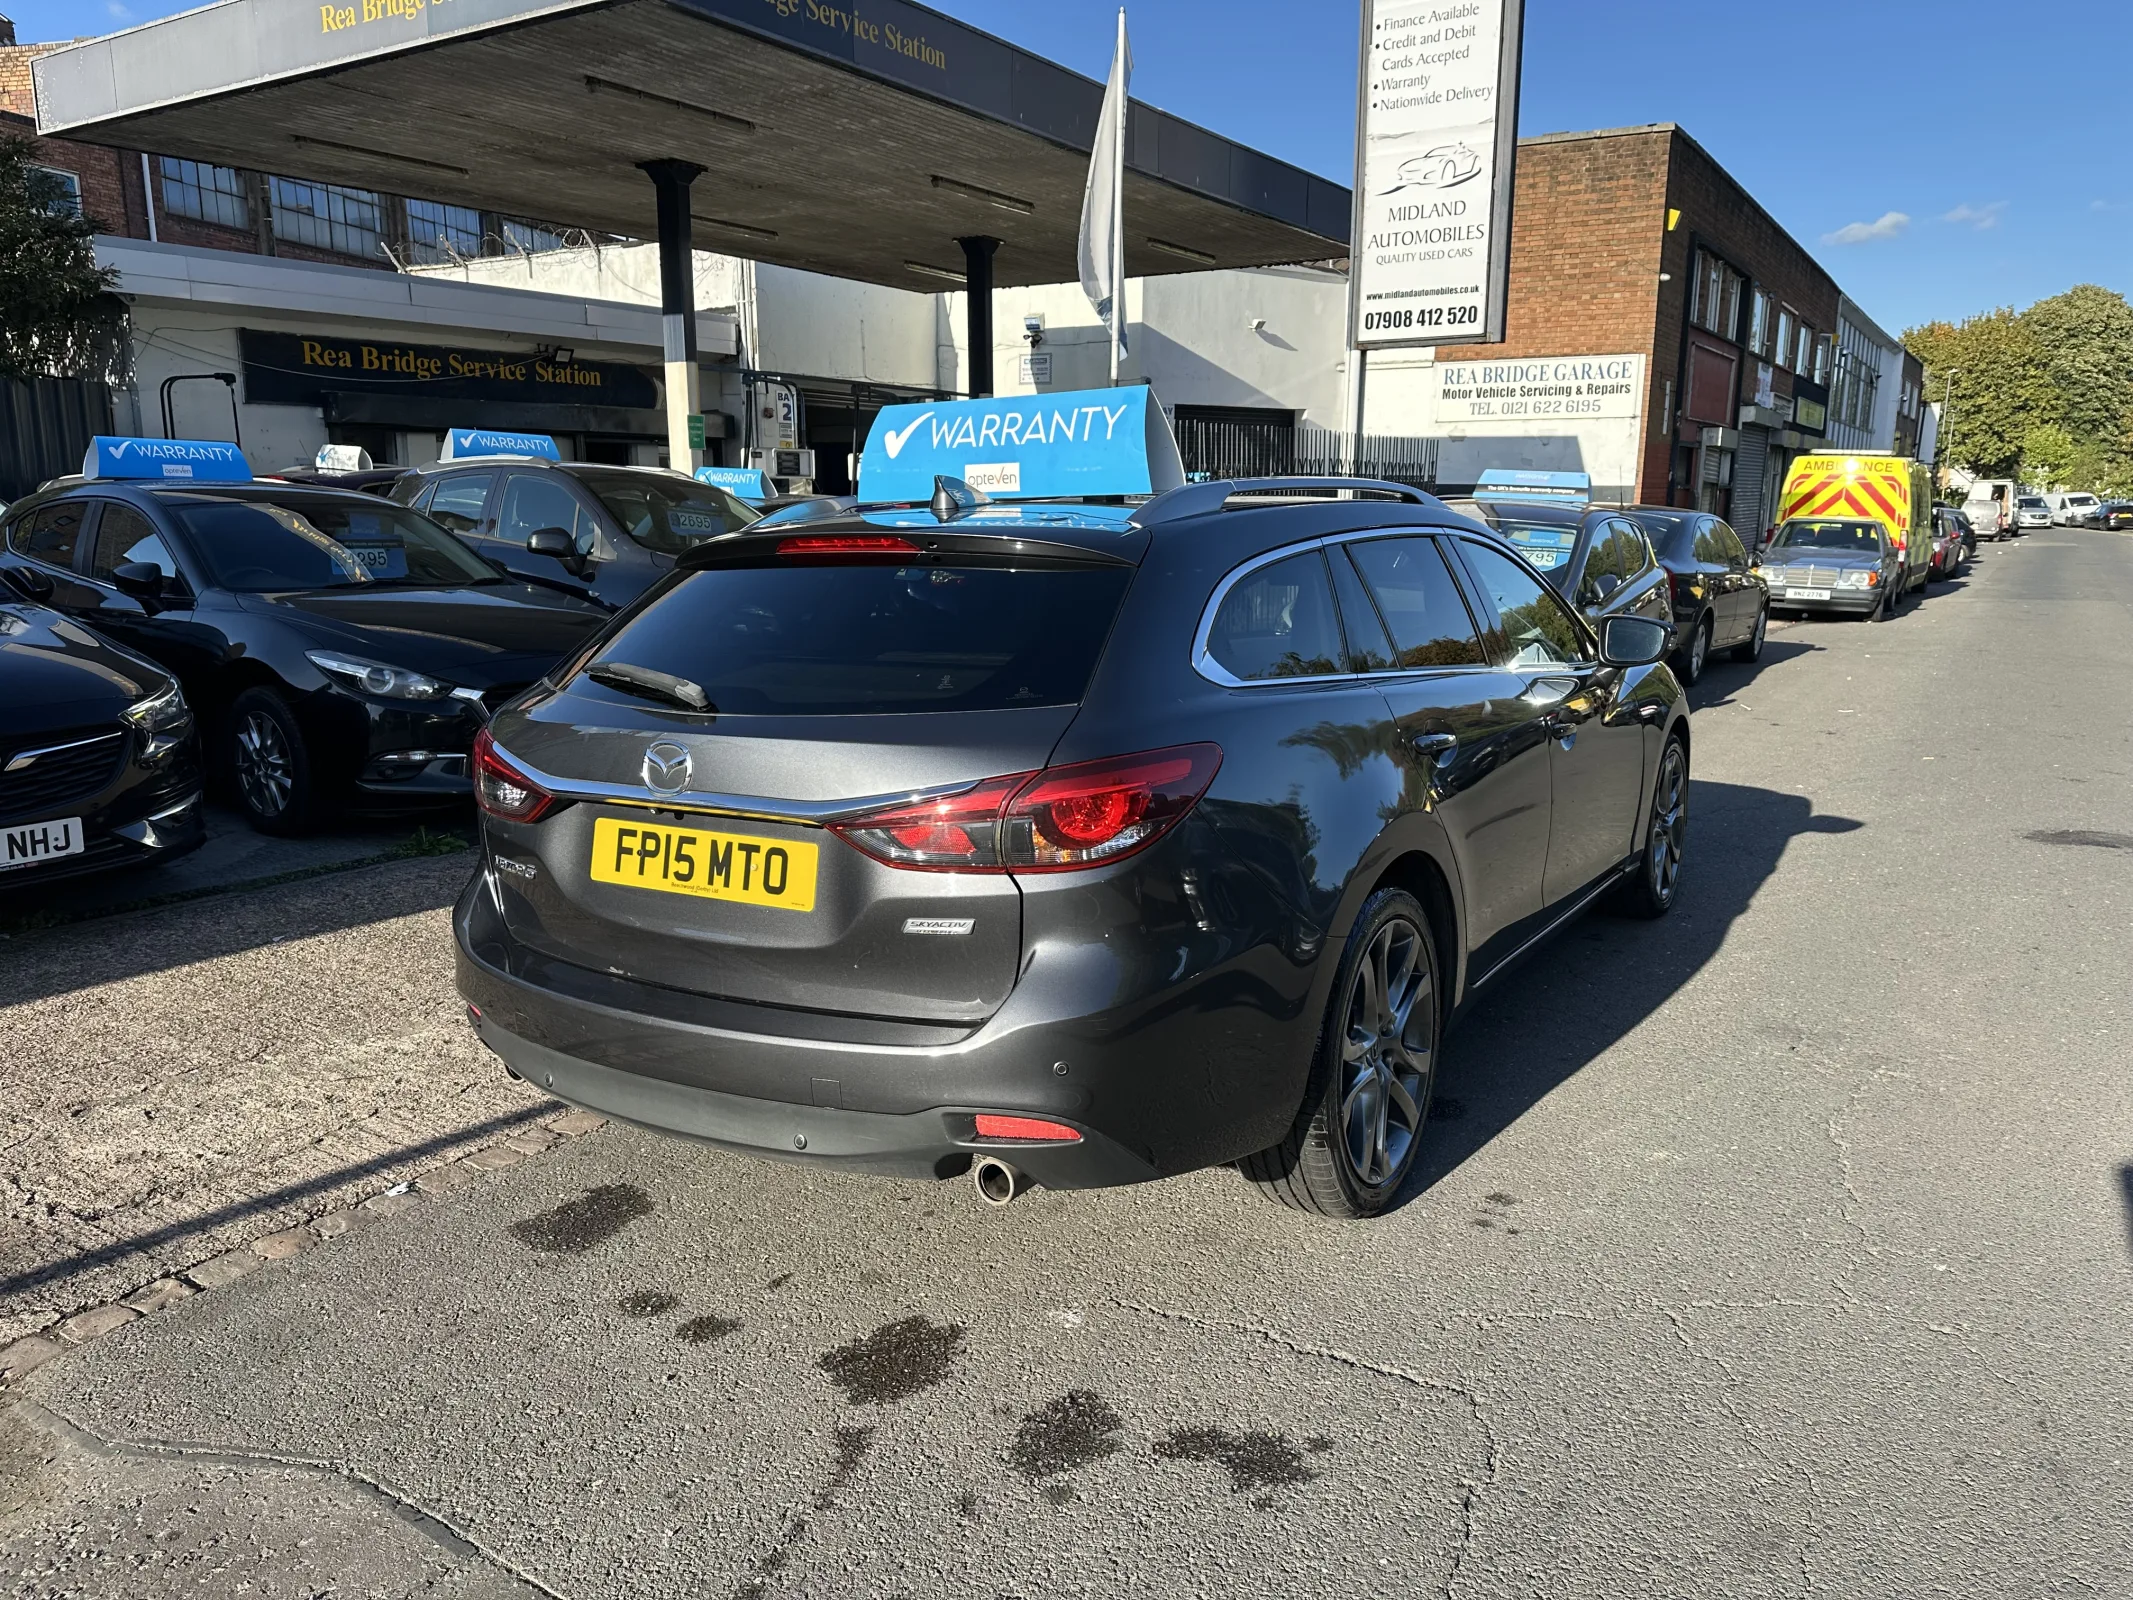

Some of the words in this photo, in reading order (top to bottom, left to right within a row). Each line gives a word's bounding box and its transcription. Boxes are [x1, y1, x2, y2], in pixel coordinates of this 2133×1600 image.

[320, 4, 356, 34] Rea
[1384, 15, 1425, 31] Finance
[1428, 3, 1479, 23] Available
[806, 0, 879, 44] Service
[885, 23, 946, 70] Station
[1383, 34, 1416, 51] Credit
[1420, 29, 1440, 45] and
[1445, 25, 1476, 41] Debit
[1382, 55, 1413, 71] Cards
[1416, 44, 1469, 66] Accepted
[1381, 74, 1430, 91] Warranty
[1380, 91, 1442, 111] Nationwide
[1446, 86, 1494, 101] Delivery
[1388, 200, 1467, 222] MIDLAND
[1367, 223, 1485, 249] AUTOMOBILES
[1376, 252, 1416, 265] QUALITY
[1419, 249, 1445, 261] USED
[1447, 247, 1473, 258] CARS
[1366, 284, 1480, 300] www.midlandautomobiles.co.uk
[1365, 310, 1413, 330] 07908
[1416, 308, 1443, 326] 412
[1447, 305, 1478, 325] 520
[302, 340, 352, 367] Rea
[360, 346, 442, 380] Bridge
[449, 353, 526, 380] Service
[535, 361, 601, 386] Station
[1444, 368, 1477, 385] REA
[1482, 364, 1550, 384] BRIDGE
[1553, 361, 1633, 382] GARAGE
[1442, 388, 1473, 400] Motor
[1475, 386, 1516, 399] Vehicle
[1520, 384, 1572, 397] Servicing
[1575, 385, 1583, 396] &
[1587, 382, 1631, 395] Repairs
[1469, 402, 1497, 415] TEL.
[1501, 401, 1528, 415] 0121
[1533, 400, 1561, 414] 622
[1565, 399, 1602, 413] 6195
[932, 404, 1127, 449] WARRANTY
[134, 443, 233, 462] WARRANTY
[477, 435, 549, 451] WARRANTY
[710, 471, 757, 484] WARRANTY
[968, 467, 1017, 487] opteven
[1804, 461, 1894, 472] AMBNCE
[680, 514, 710, 529] 2695
[7, 823, 71, 860] NHJ
[615, 828, 697, 882] FP15
[708, 839, 788, 895] MTO
